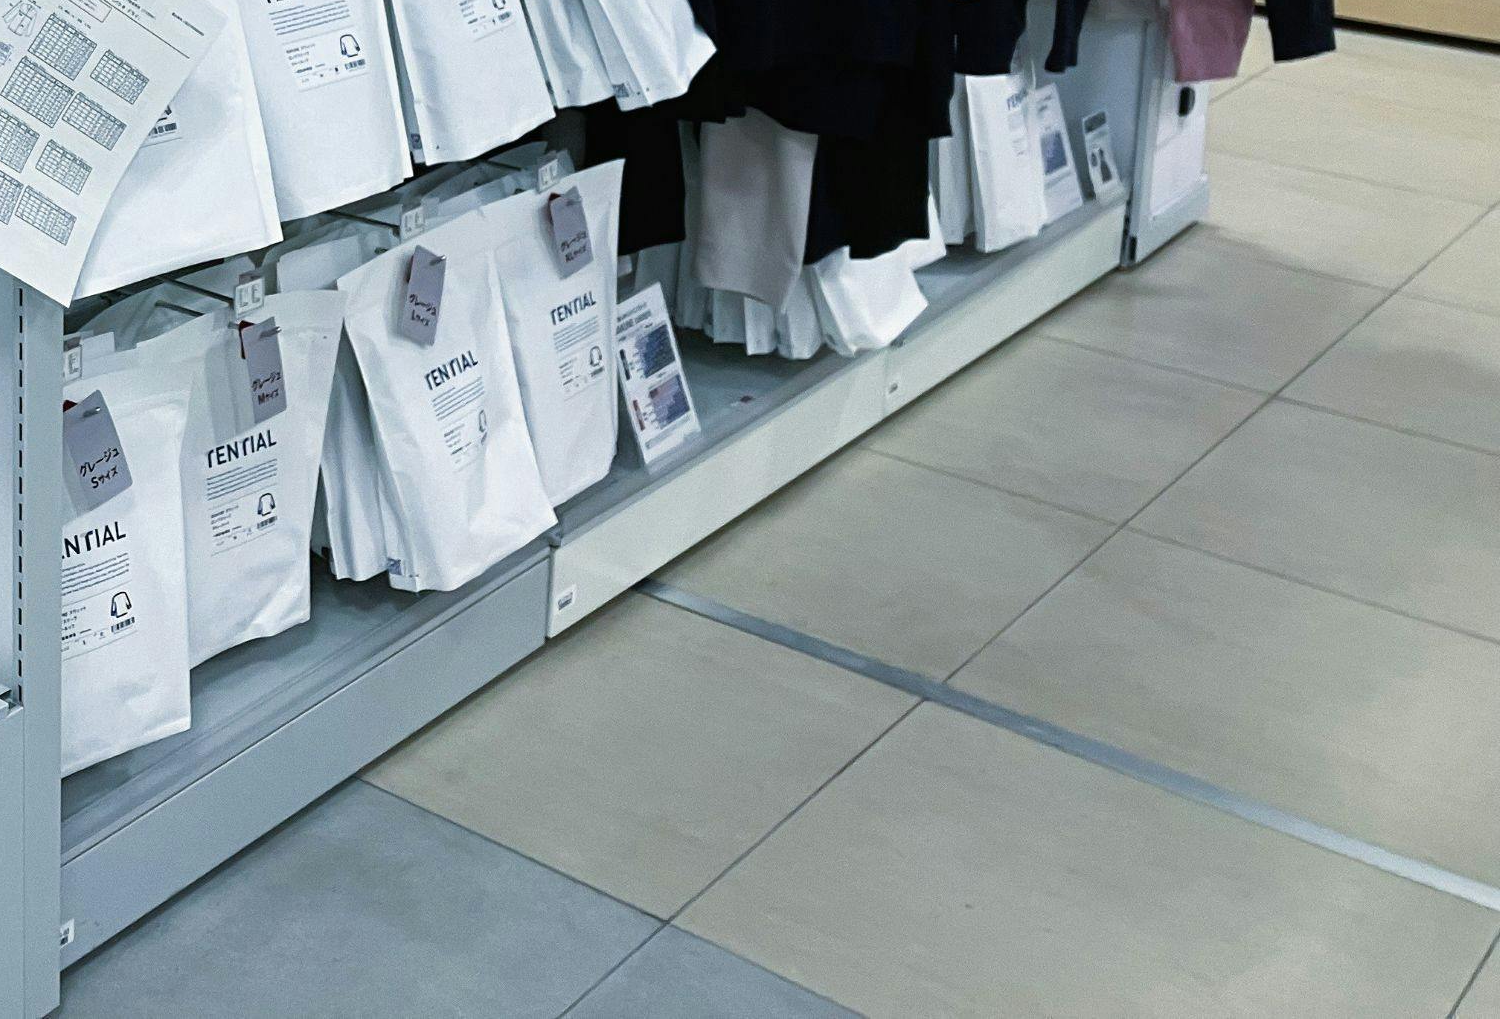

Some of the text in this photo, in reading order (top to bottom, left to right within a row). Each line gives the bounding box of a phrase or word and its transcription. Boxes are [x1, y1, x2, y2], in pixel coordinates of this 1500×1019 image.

[409, 293, 436, 316] グレージュ
[550, 291, 596, 325] TENTIAL
[251, 370, 282, 392] グレージュ
[424, 350, 479, 391] TENTIAL
[257, 388, 280, 405] Mサイズ
[79, 446, 120, 477] グレージュ
[207, 430, 277, 468] TENTIAL
[91, 466, 118, 488] Sサイズ
